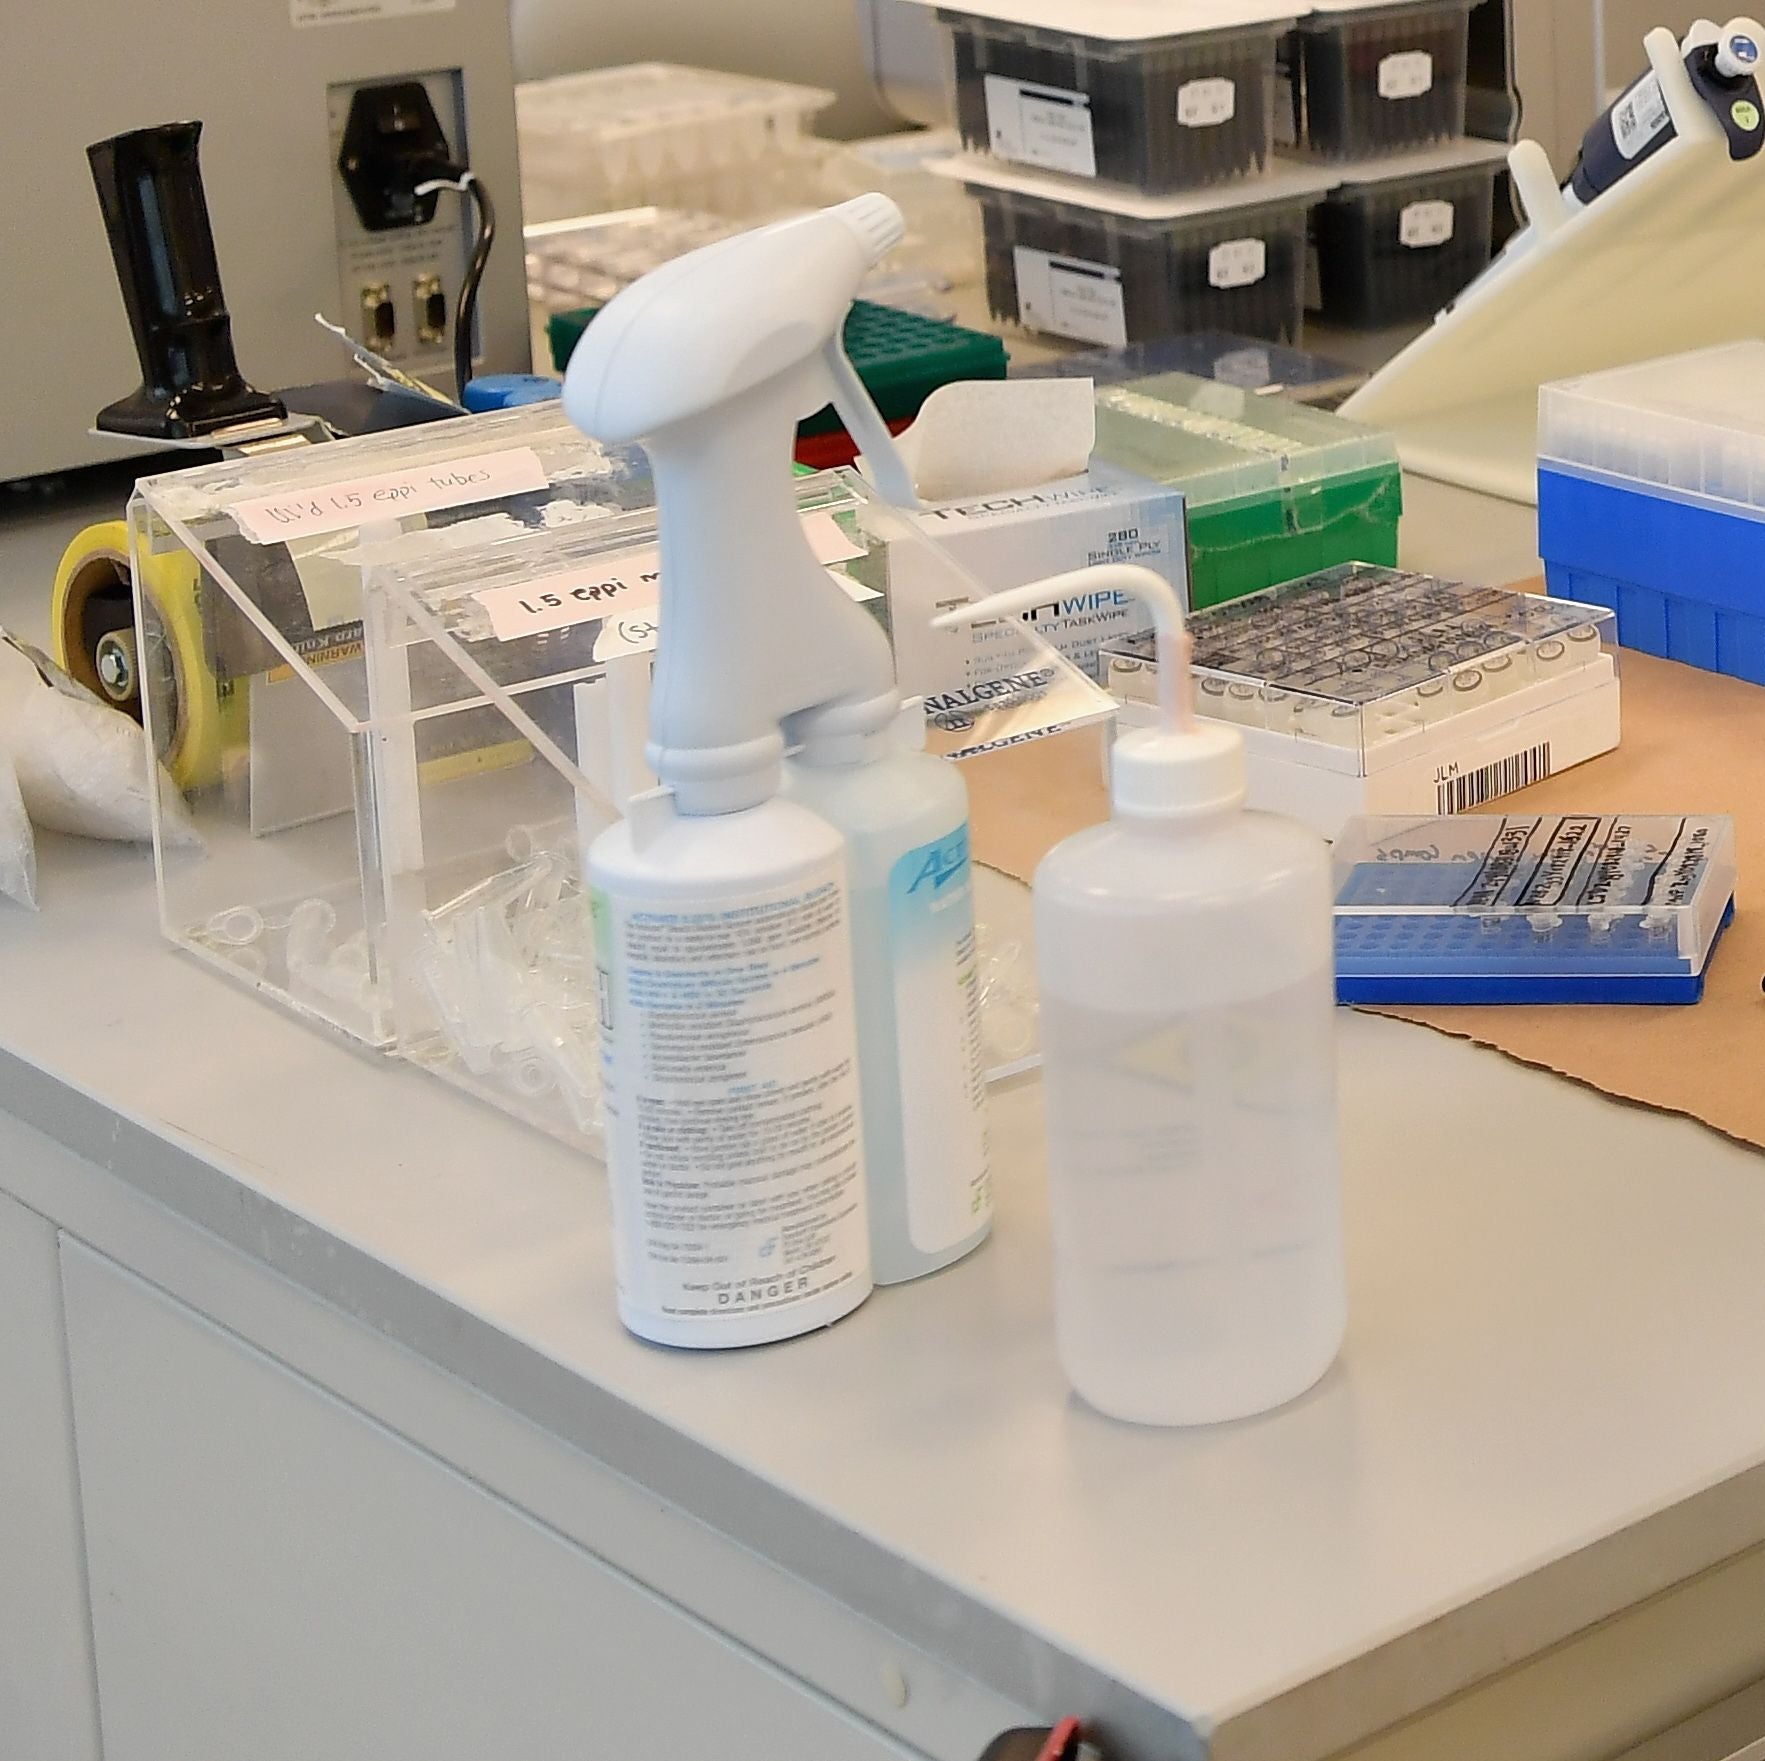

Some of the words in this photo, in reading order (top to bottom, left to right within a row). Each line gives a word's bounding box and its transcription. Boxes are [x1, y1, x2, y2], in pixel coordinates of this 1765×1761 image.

[330, 491, 363, 509] 1.5
[373, 483, 418, 501] eppi
[429, 469, 492, 491] tubes
[1108, 527, 1139, 543] 280
[518, 592, 563, 614] 1.5
[568, 576, 629, 601] eppi
[307, 642, 362, 666] WARNIN
[1433, 761, 1460, 784] JLM
[718, 1276, 809, 1305] DANGER
